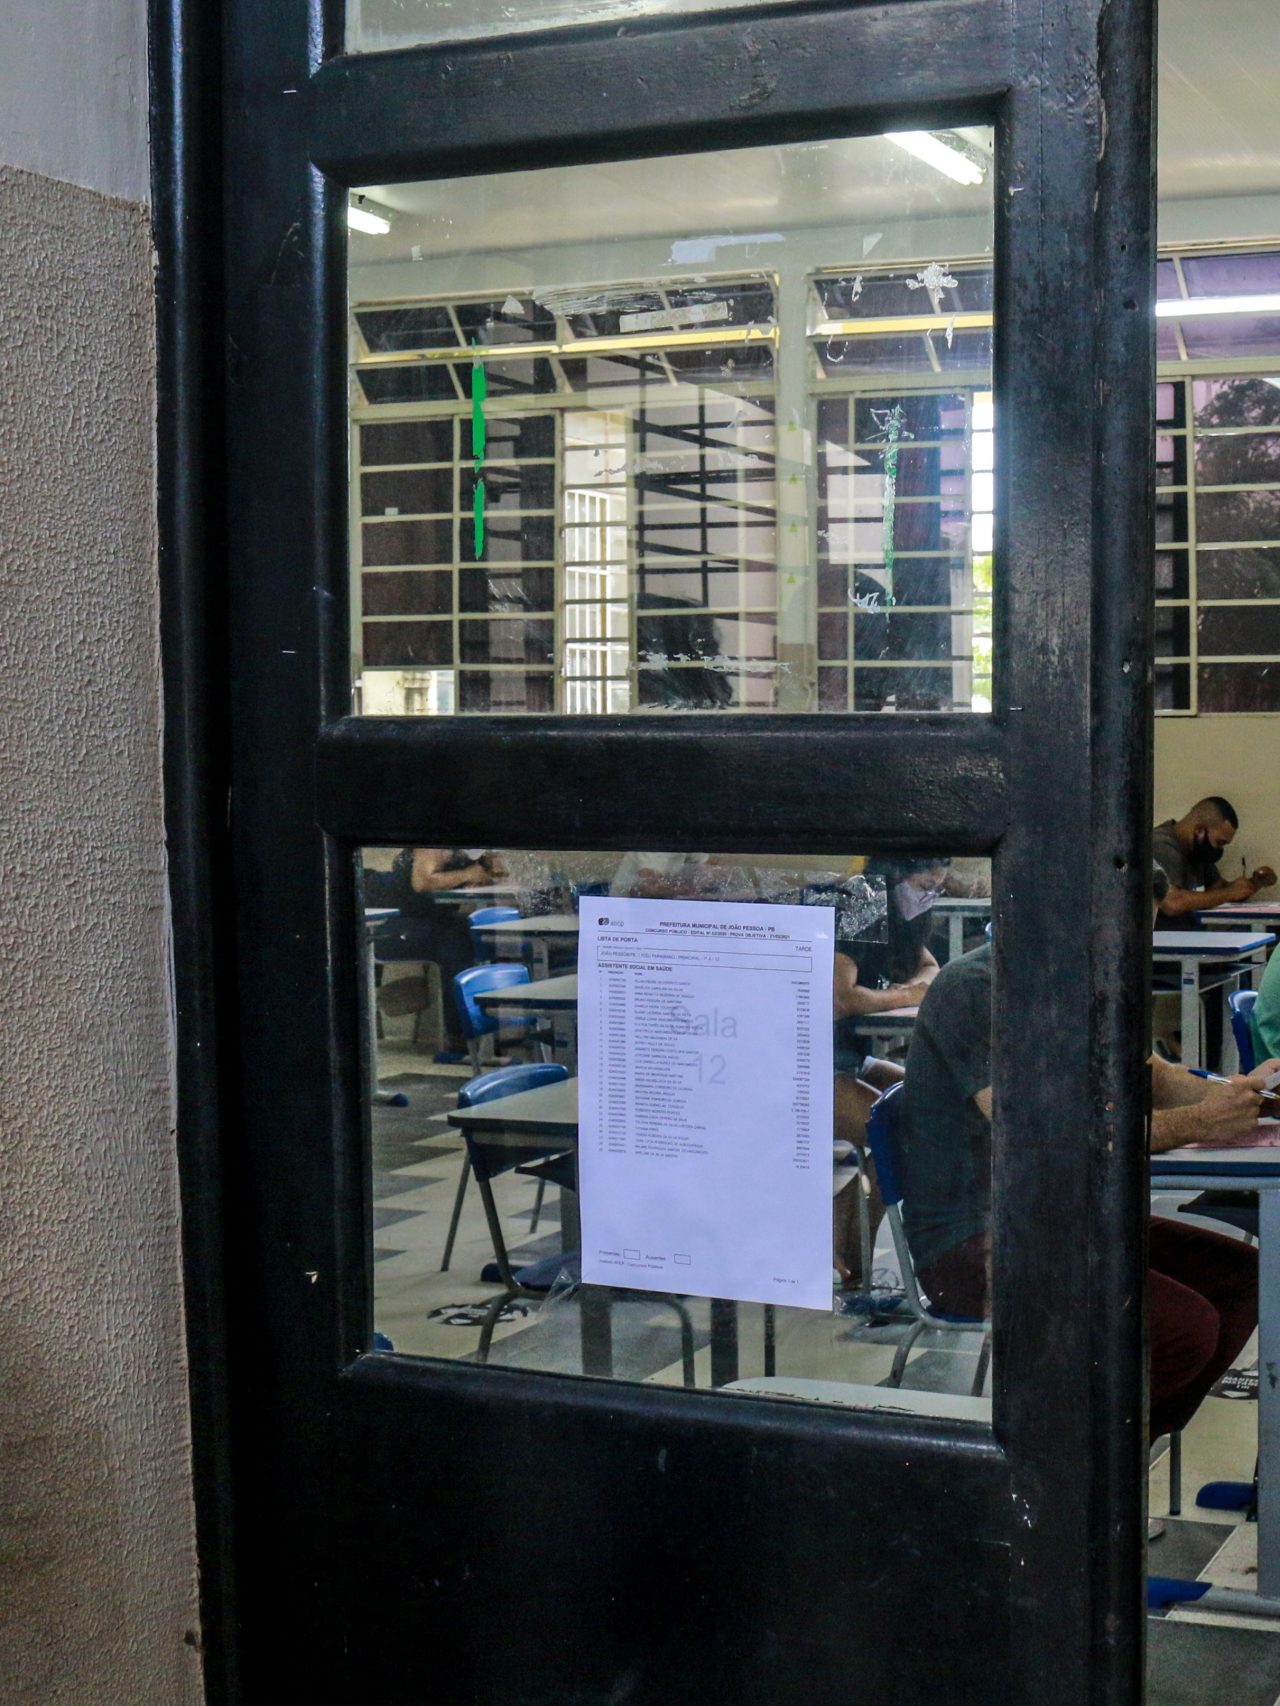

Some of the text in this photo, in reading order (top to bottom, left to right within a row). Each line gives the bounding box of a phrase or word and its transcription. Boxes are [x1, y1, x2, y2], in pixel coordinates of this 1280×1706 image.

[691, 922, 719, 930] MUNICIPAL
[728, 923, 741, 931] JOÃO
[671, 1005, 737, 1039] Sala
[693, 1053, 726, 1085] 12
